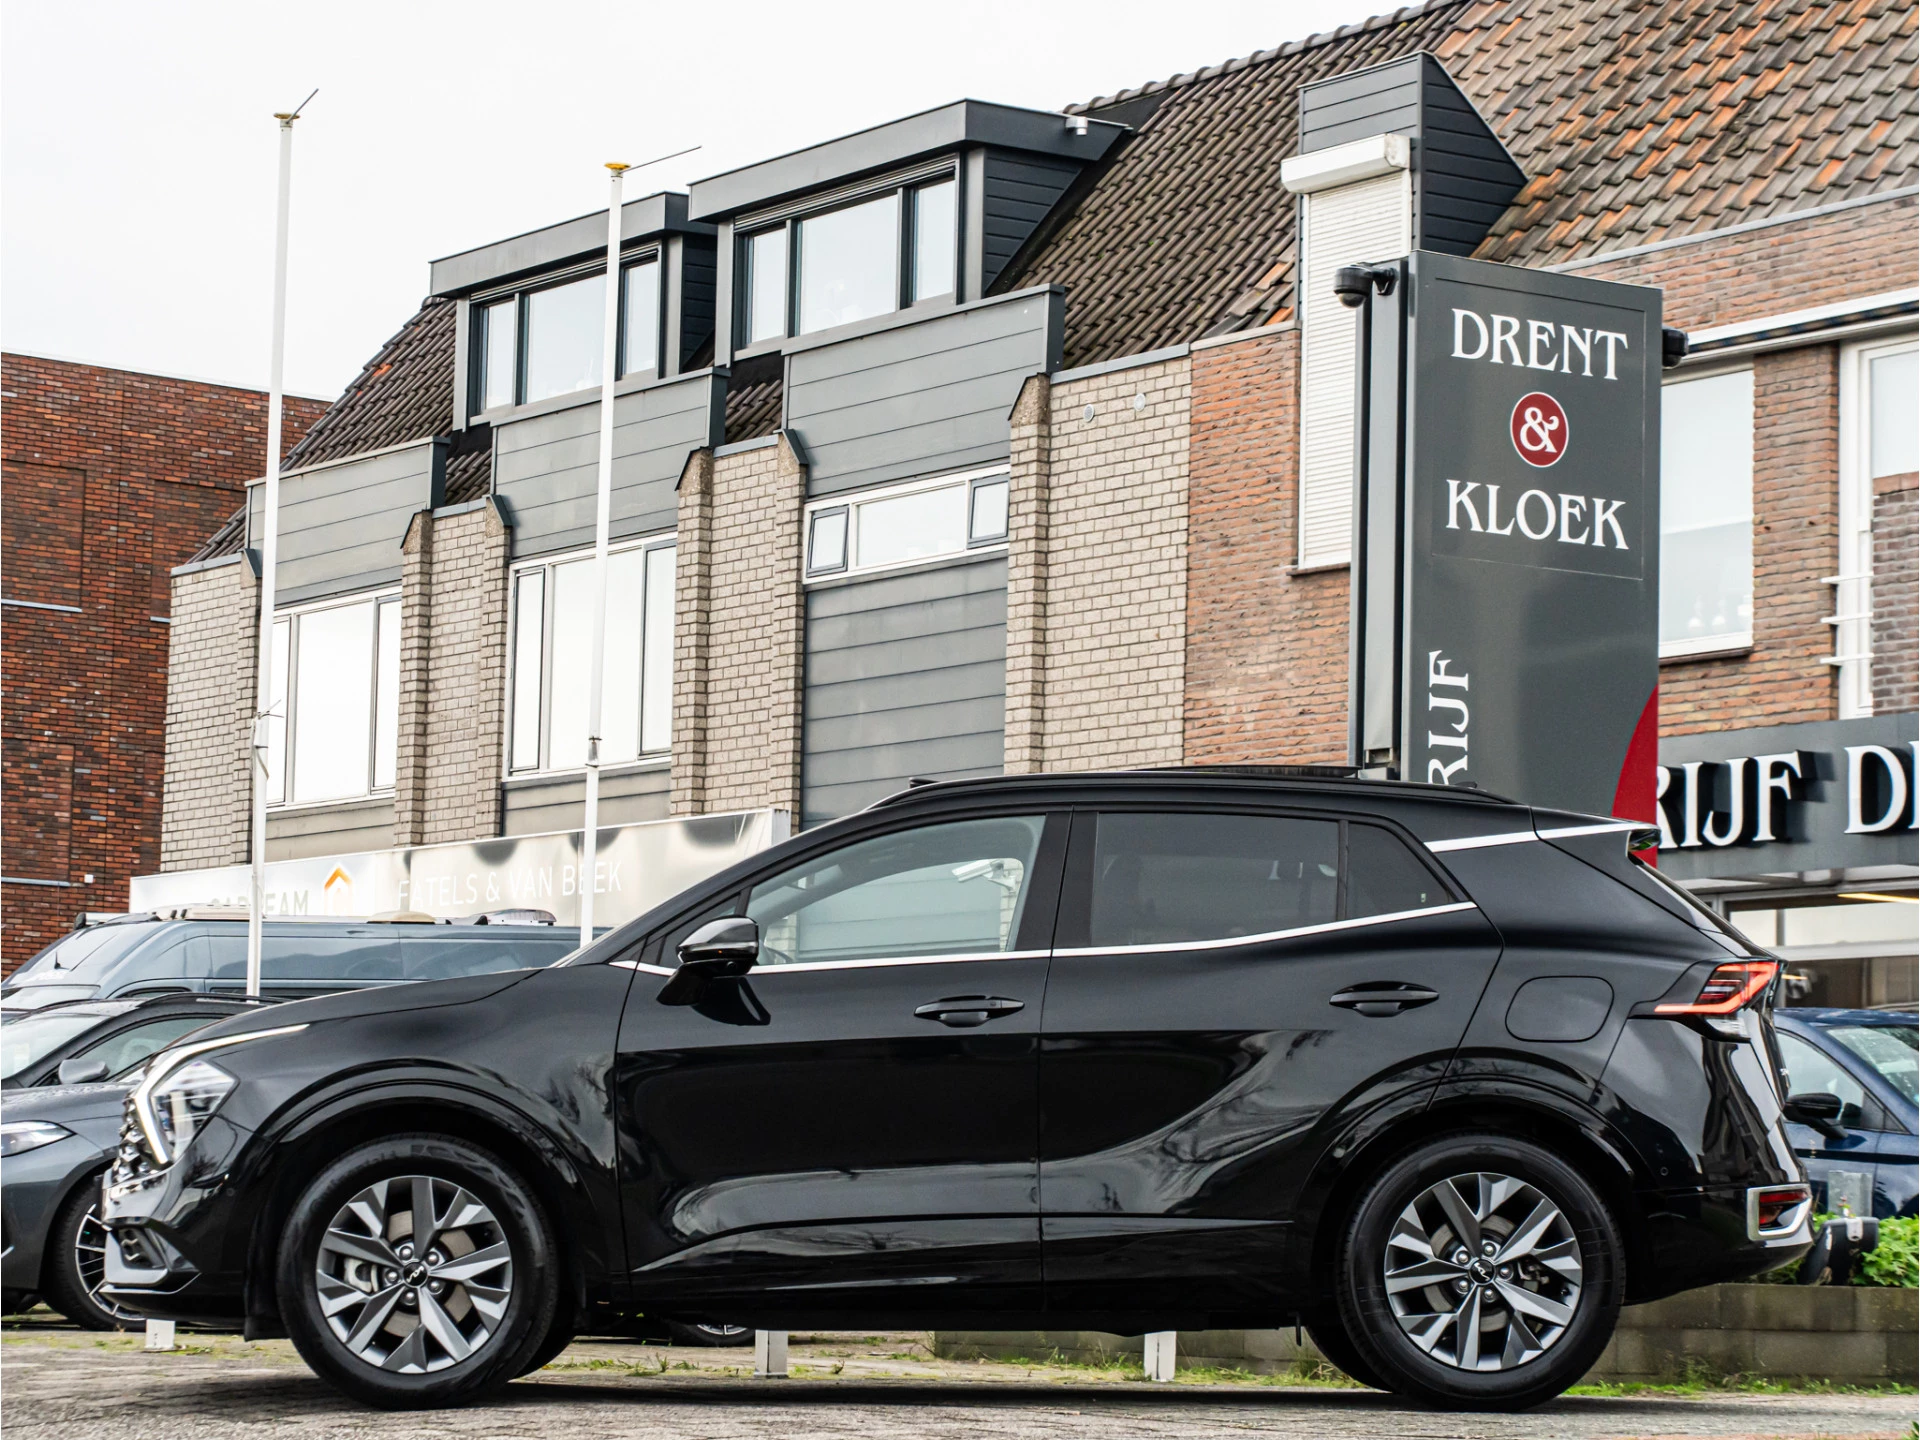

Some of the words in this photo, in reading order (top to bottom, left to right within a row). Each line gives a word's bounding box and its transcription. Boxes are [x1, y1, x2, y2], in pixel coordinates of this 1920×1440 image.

[1450, 308, 1629, 381] DRENT
[1519, 406, 1560, 454] &
[1445, 479, 1630, 550] KLOEK
[1843, 740, 1919, 834] D
[485, 871, 501, 902] &
[509, 866, 553, 900] VAN
